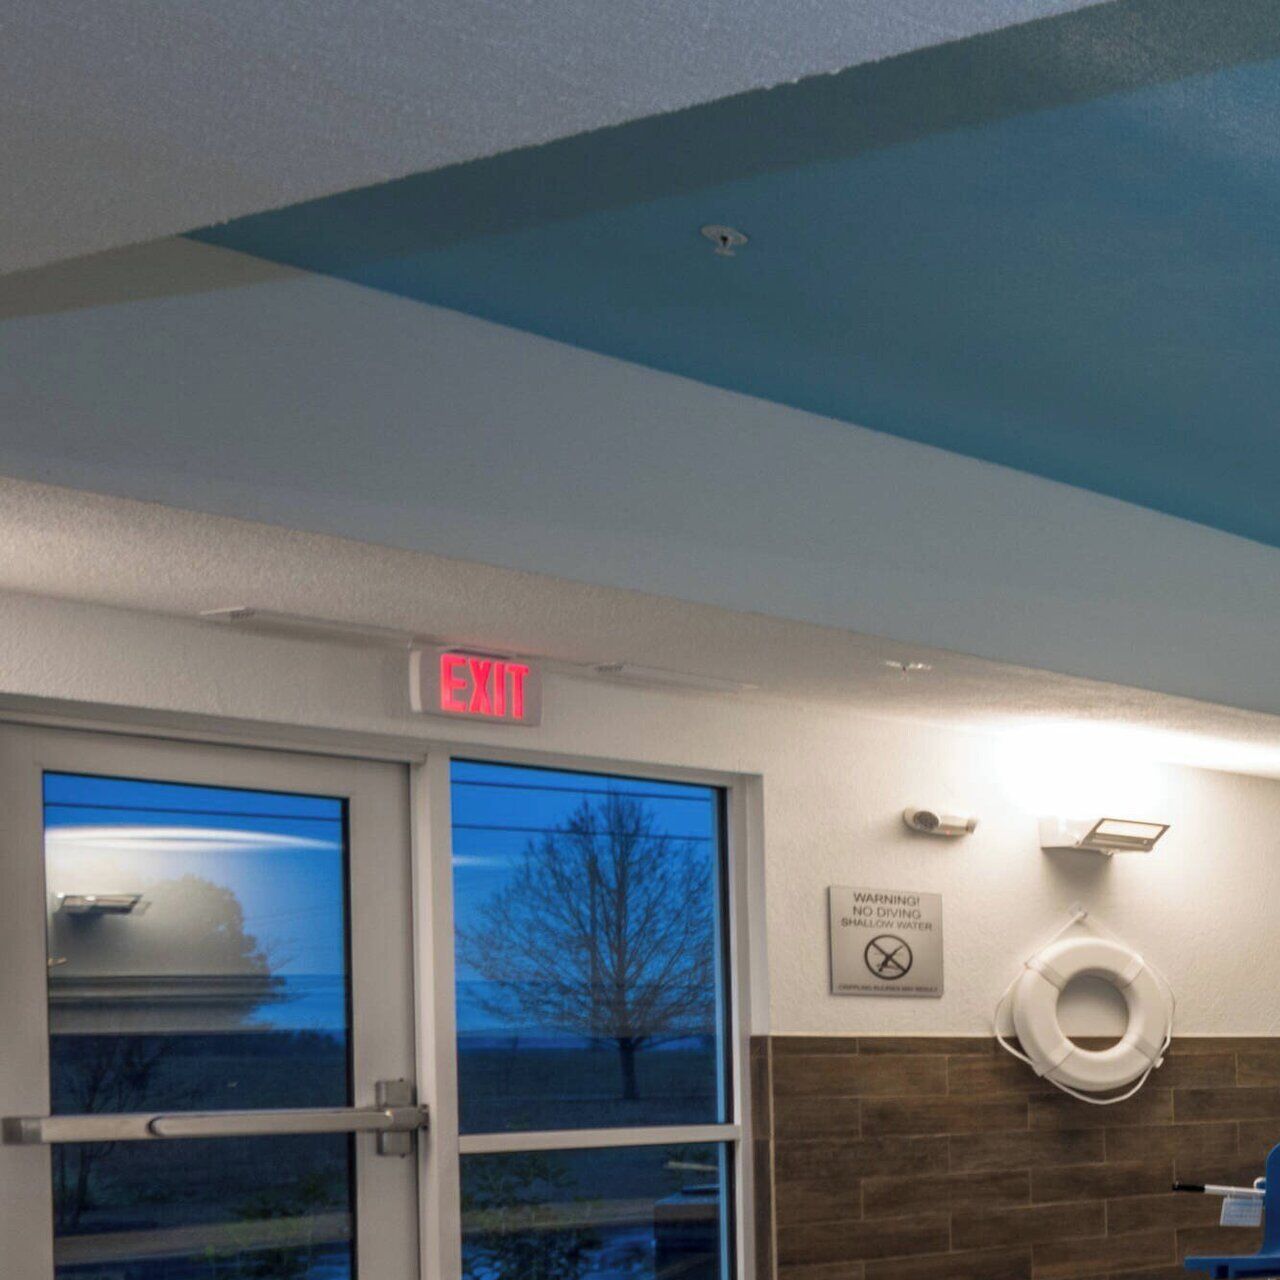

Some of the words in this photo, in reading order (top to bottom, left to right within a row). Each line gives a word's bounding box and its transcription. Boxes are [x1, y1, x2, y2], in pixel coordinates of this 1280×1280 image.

[440, 652, 529, 721] EXIT
[853, 892, 920, 907] WARNING!
[853, 905, 873, 917] NO
[877, 907, 922, 920] DIVING
[841, 917, 893, 929] SHALLOW
[897, 921, 932, 932] WATER
